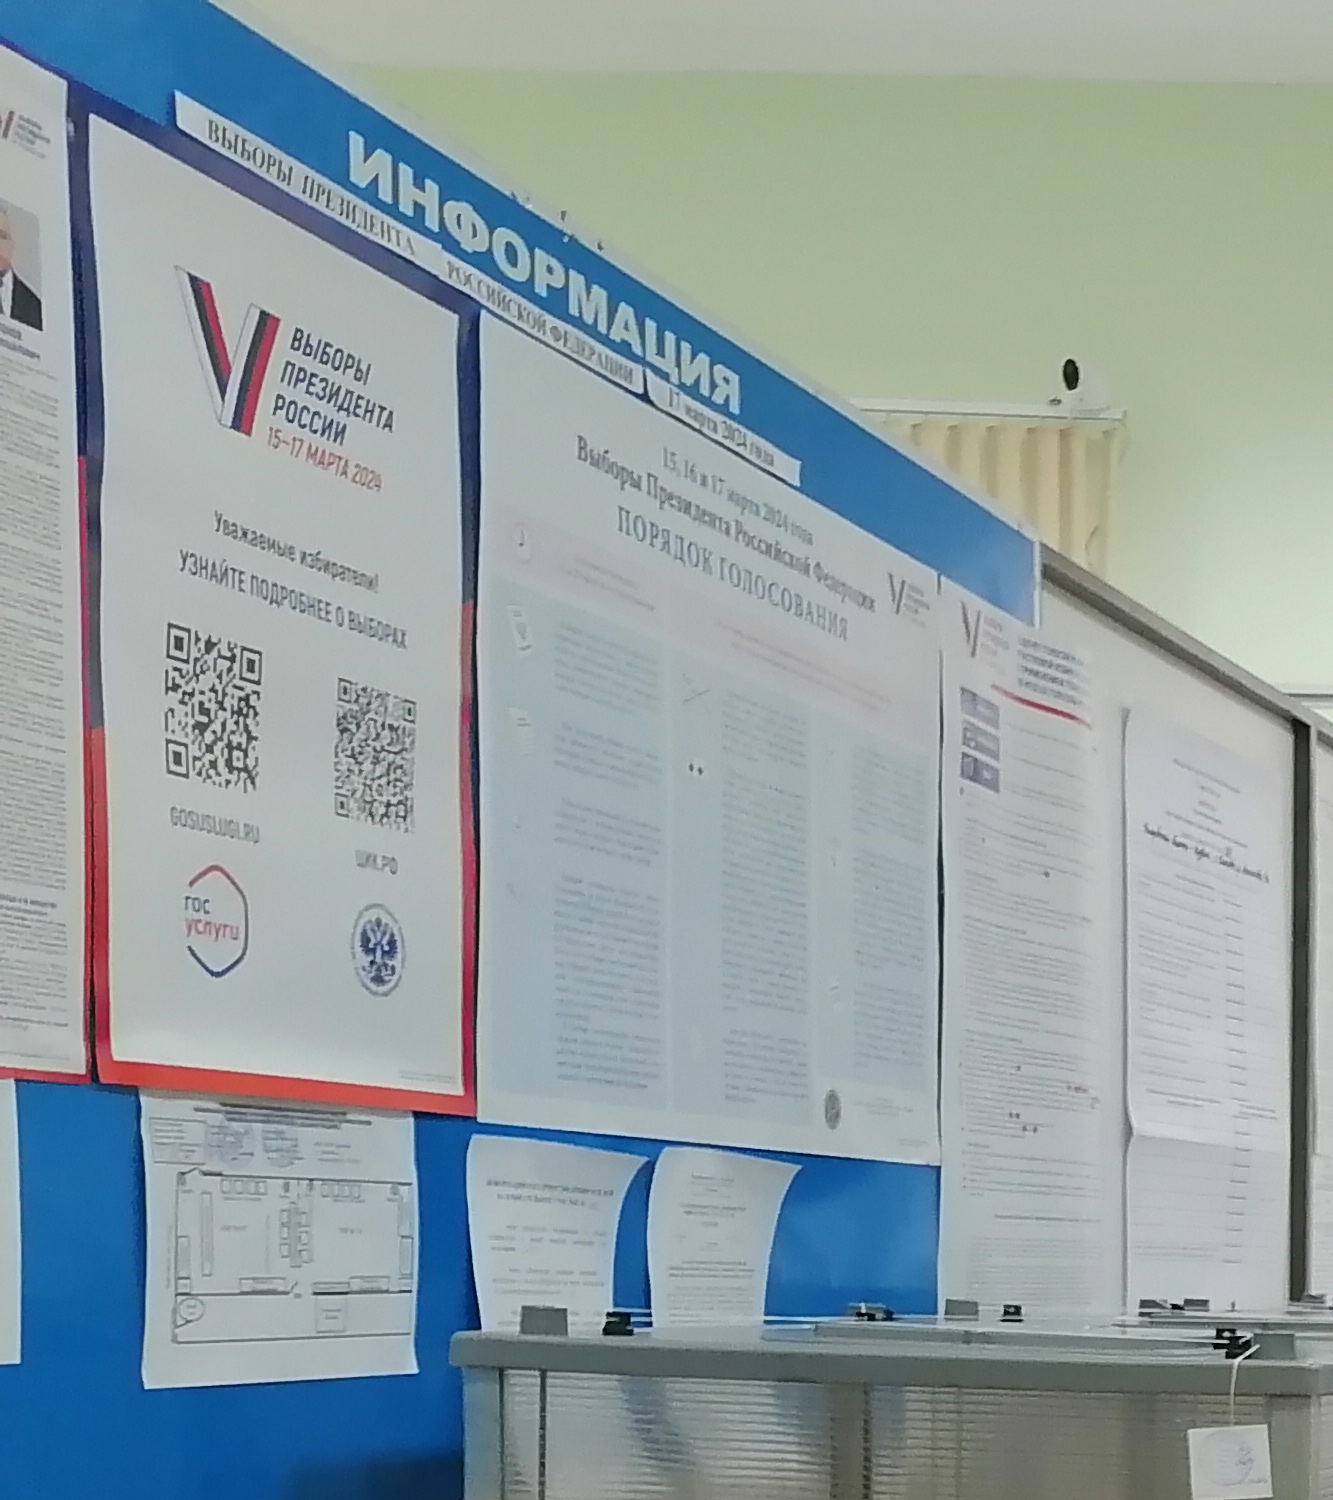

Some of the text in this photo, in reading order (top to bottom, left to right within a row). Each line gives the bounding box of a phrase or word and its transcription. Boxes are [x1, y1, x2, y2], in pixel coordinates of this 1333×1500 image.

[207, 119, 634, 385] ВЫБОРЫ ПРЕЗИДЕНТА РОССИЙСКОЙ ФЕДЕРАЦИИ
[347, 129, 741, 415] ИНФОРМАЦИЯ
[289, 327, 372, 386] ВЫБОРЫ
[272, 393, 348, 446] РОССИИ
[280, 361, 395, 433] ПРЕЗИДЕНТА
[305, 441, 349, 479] МАРТА
[351, 463, 384, 492] 2024
[214, 510, 379, 593] Уважаемые избиратели!
[577, 435, 642, 491] Выборы
[646, 471, 731, 538] Президента
[734, 519, 811, 579] Российской
[812, 561, 876, 613] Федерации
[179, 549, 408, 650] УЗНАЙТЕ ПОДРОБНЕЕ О ВЫБОРАХ
[617, 505, 713, 576] ПОРЯДОК
[719, 556, 848, 641] ГОЛОСОВАНИЯ
[170, 805, 260, 844] GOSUSLUGI.RU
[184, 895, 211, 915] гос
